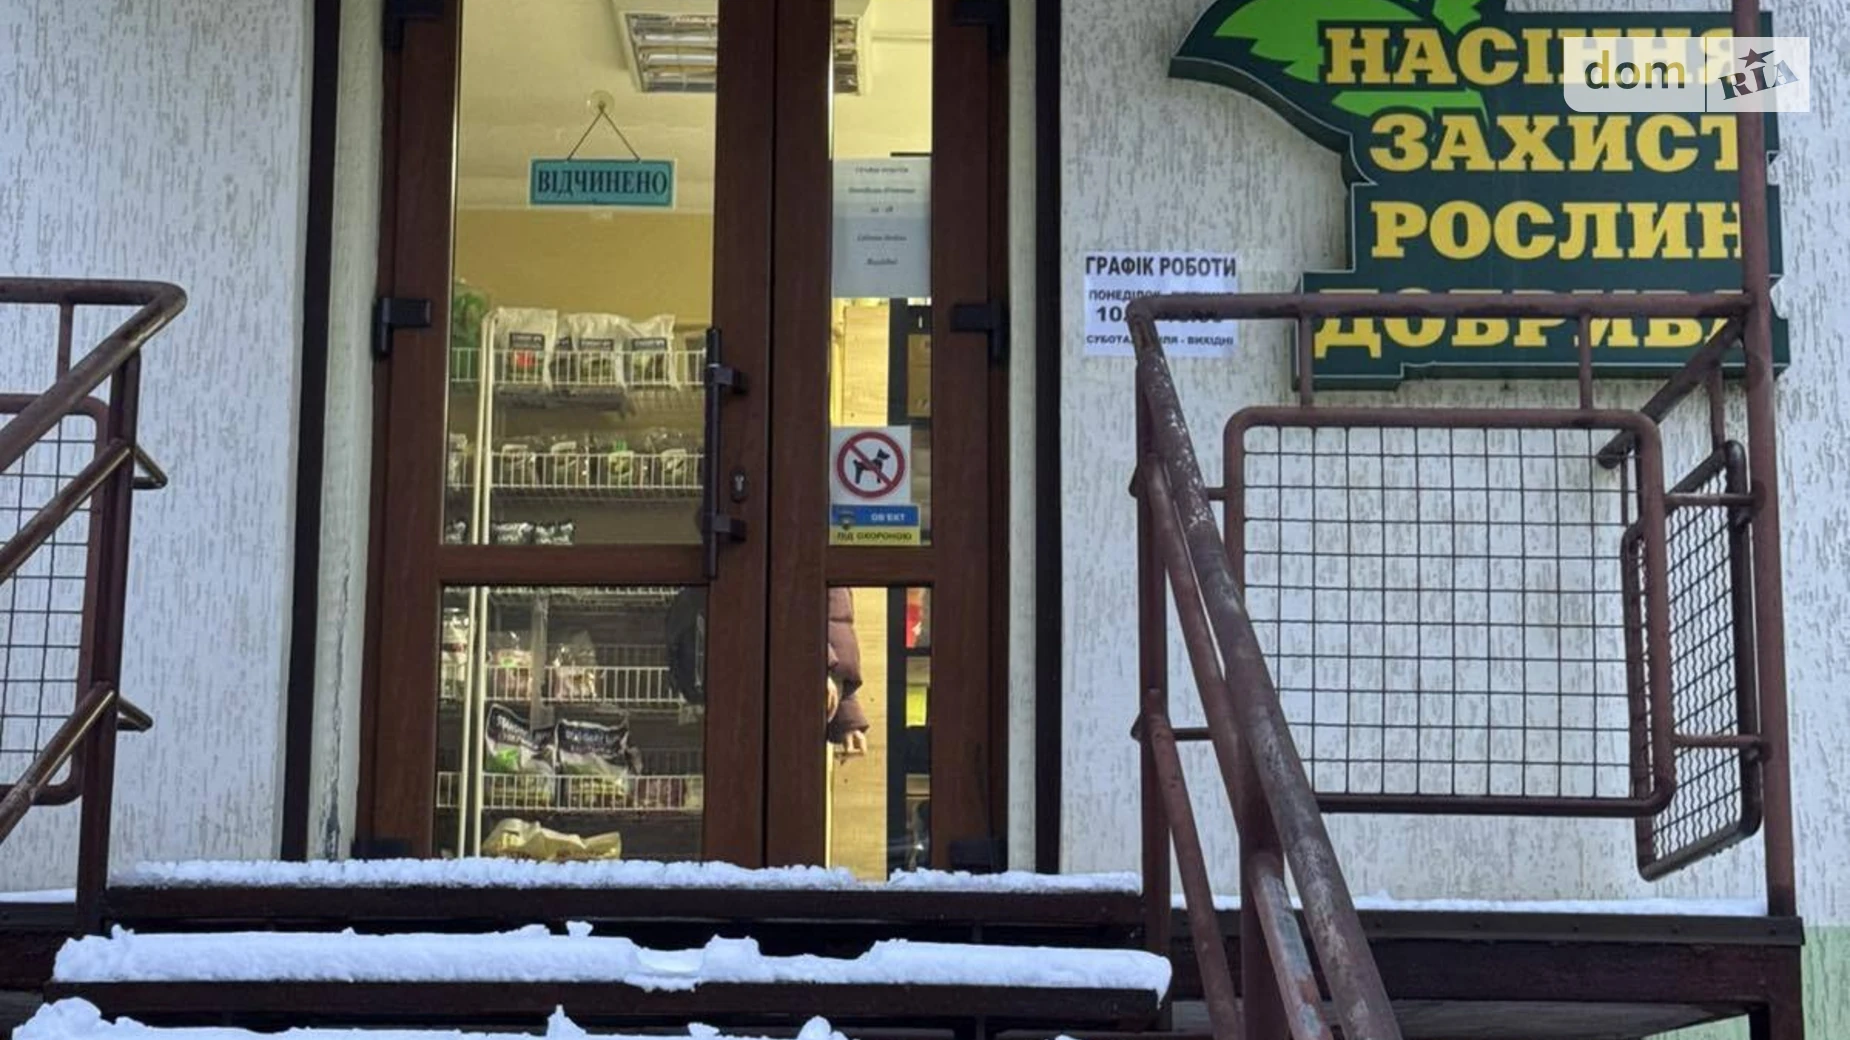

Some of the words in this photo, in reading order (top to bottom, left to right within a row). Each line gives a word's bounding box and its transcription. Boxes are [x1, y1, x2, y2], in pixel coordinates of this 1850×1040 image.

[1325, 26, 1735, 86] НАСІННЯ
[1369, 112, 1739, 172] ЗАХИСТ
[537, 169, 668, 197] ВІДЧИНЕНО
[1370, 200, 1742, 261] РОСЛИН
[1085, 255, 1155, 276] ГРАФІК
[1159, 256, 1237, 278] РОБОТИ
[1187, 335, 1234, 347] ВИХІДНІ
